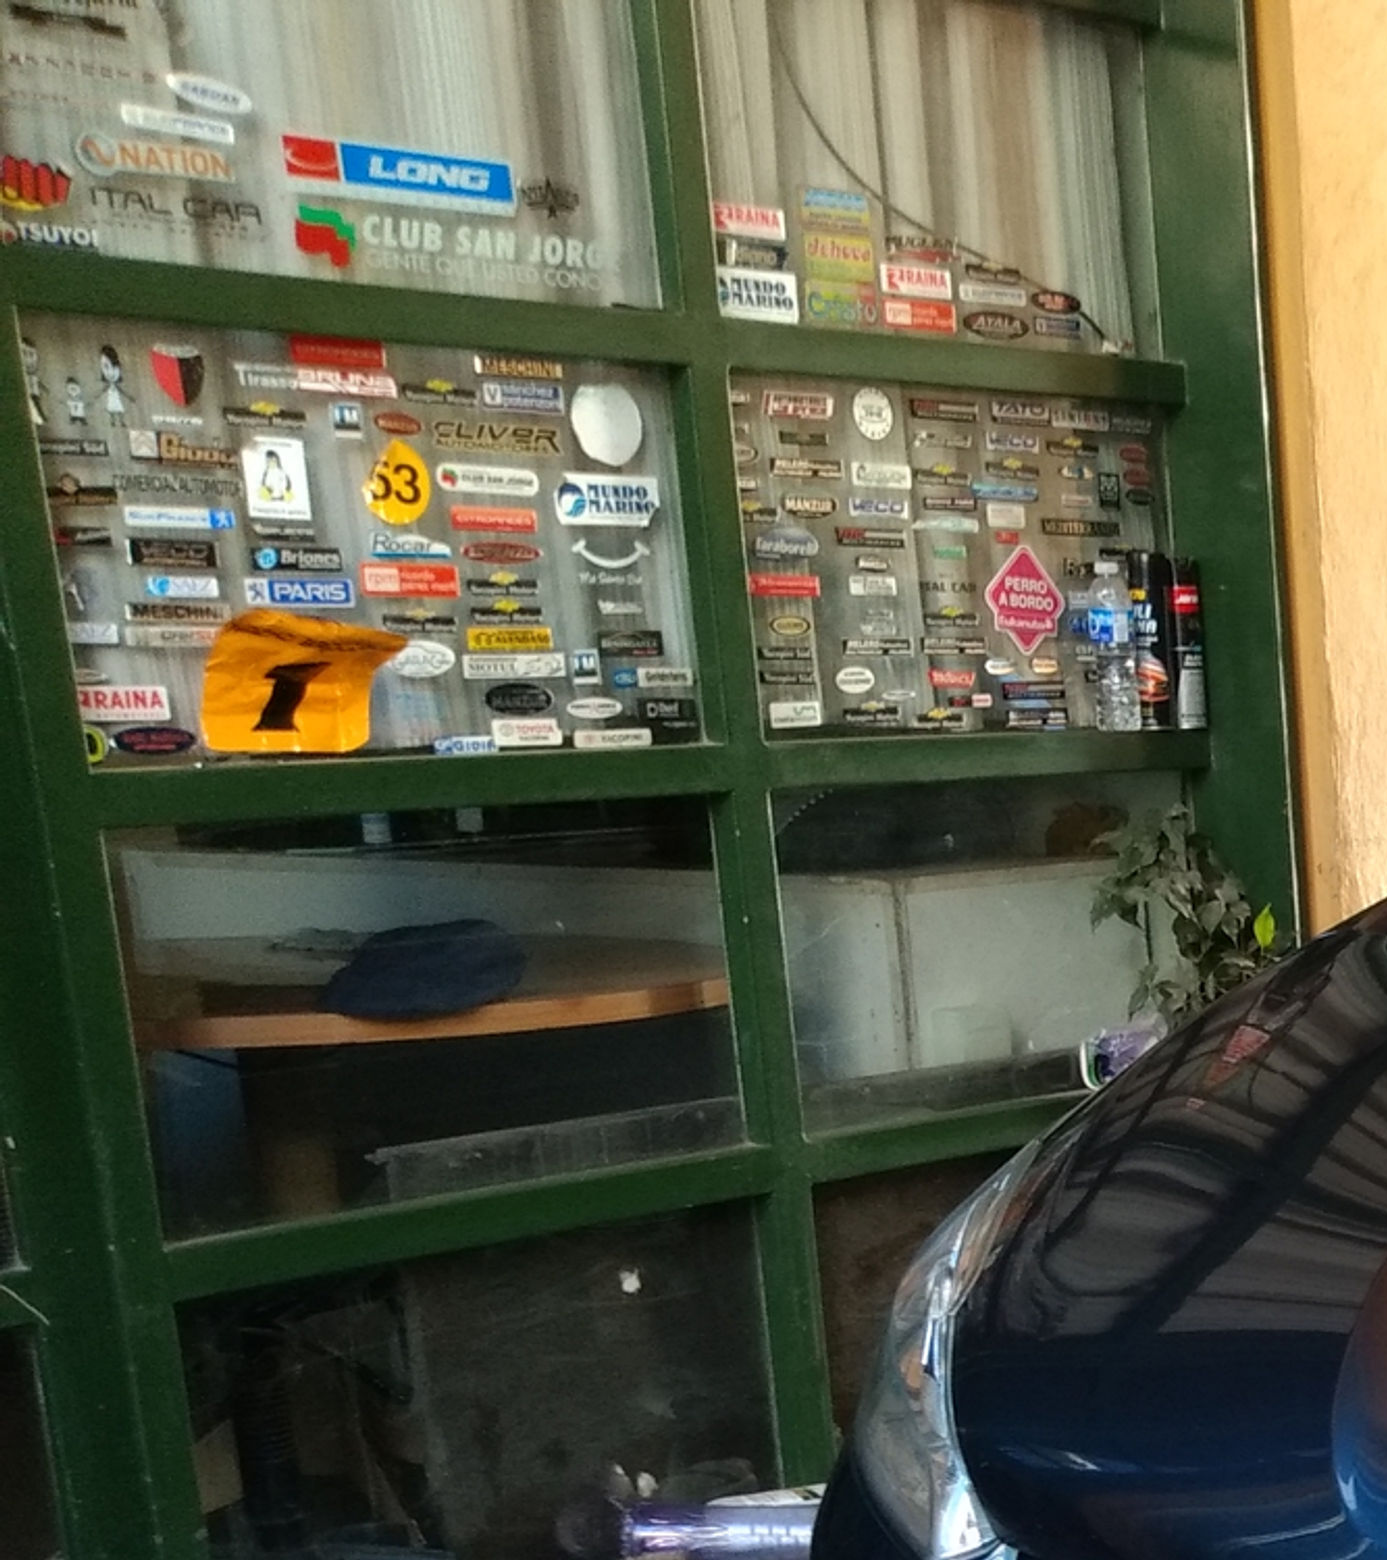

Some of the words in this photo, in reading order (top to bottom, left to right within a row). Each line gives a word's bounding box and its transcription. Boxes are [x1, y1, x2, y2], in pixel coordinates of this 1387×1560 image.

[119, 141, 232, 179] NATION
[368, 155, 492, 192] LONG
[362, 215, 443, 252] CLUB
[456, 226, 517, 259] SAN
[730, 277, 787, 296] MUNDO
[731, 292, 794, 312] MARINO
[586, 483, 647, 500] MUNDO
[588, 498, 655, 516] MARINO
[372, 532, 433, 554] Rocar
[272, 583, 347, 602] PARIS
[1004, 576, 1048, 594] PERRO
[1000, 592, 1009, 607] A
[1010, 594, 1054, 612] BORDO
[252, 661, 333, 732] 1
